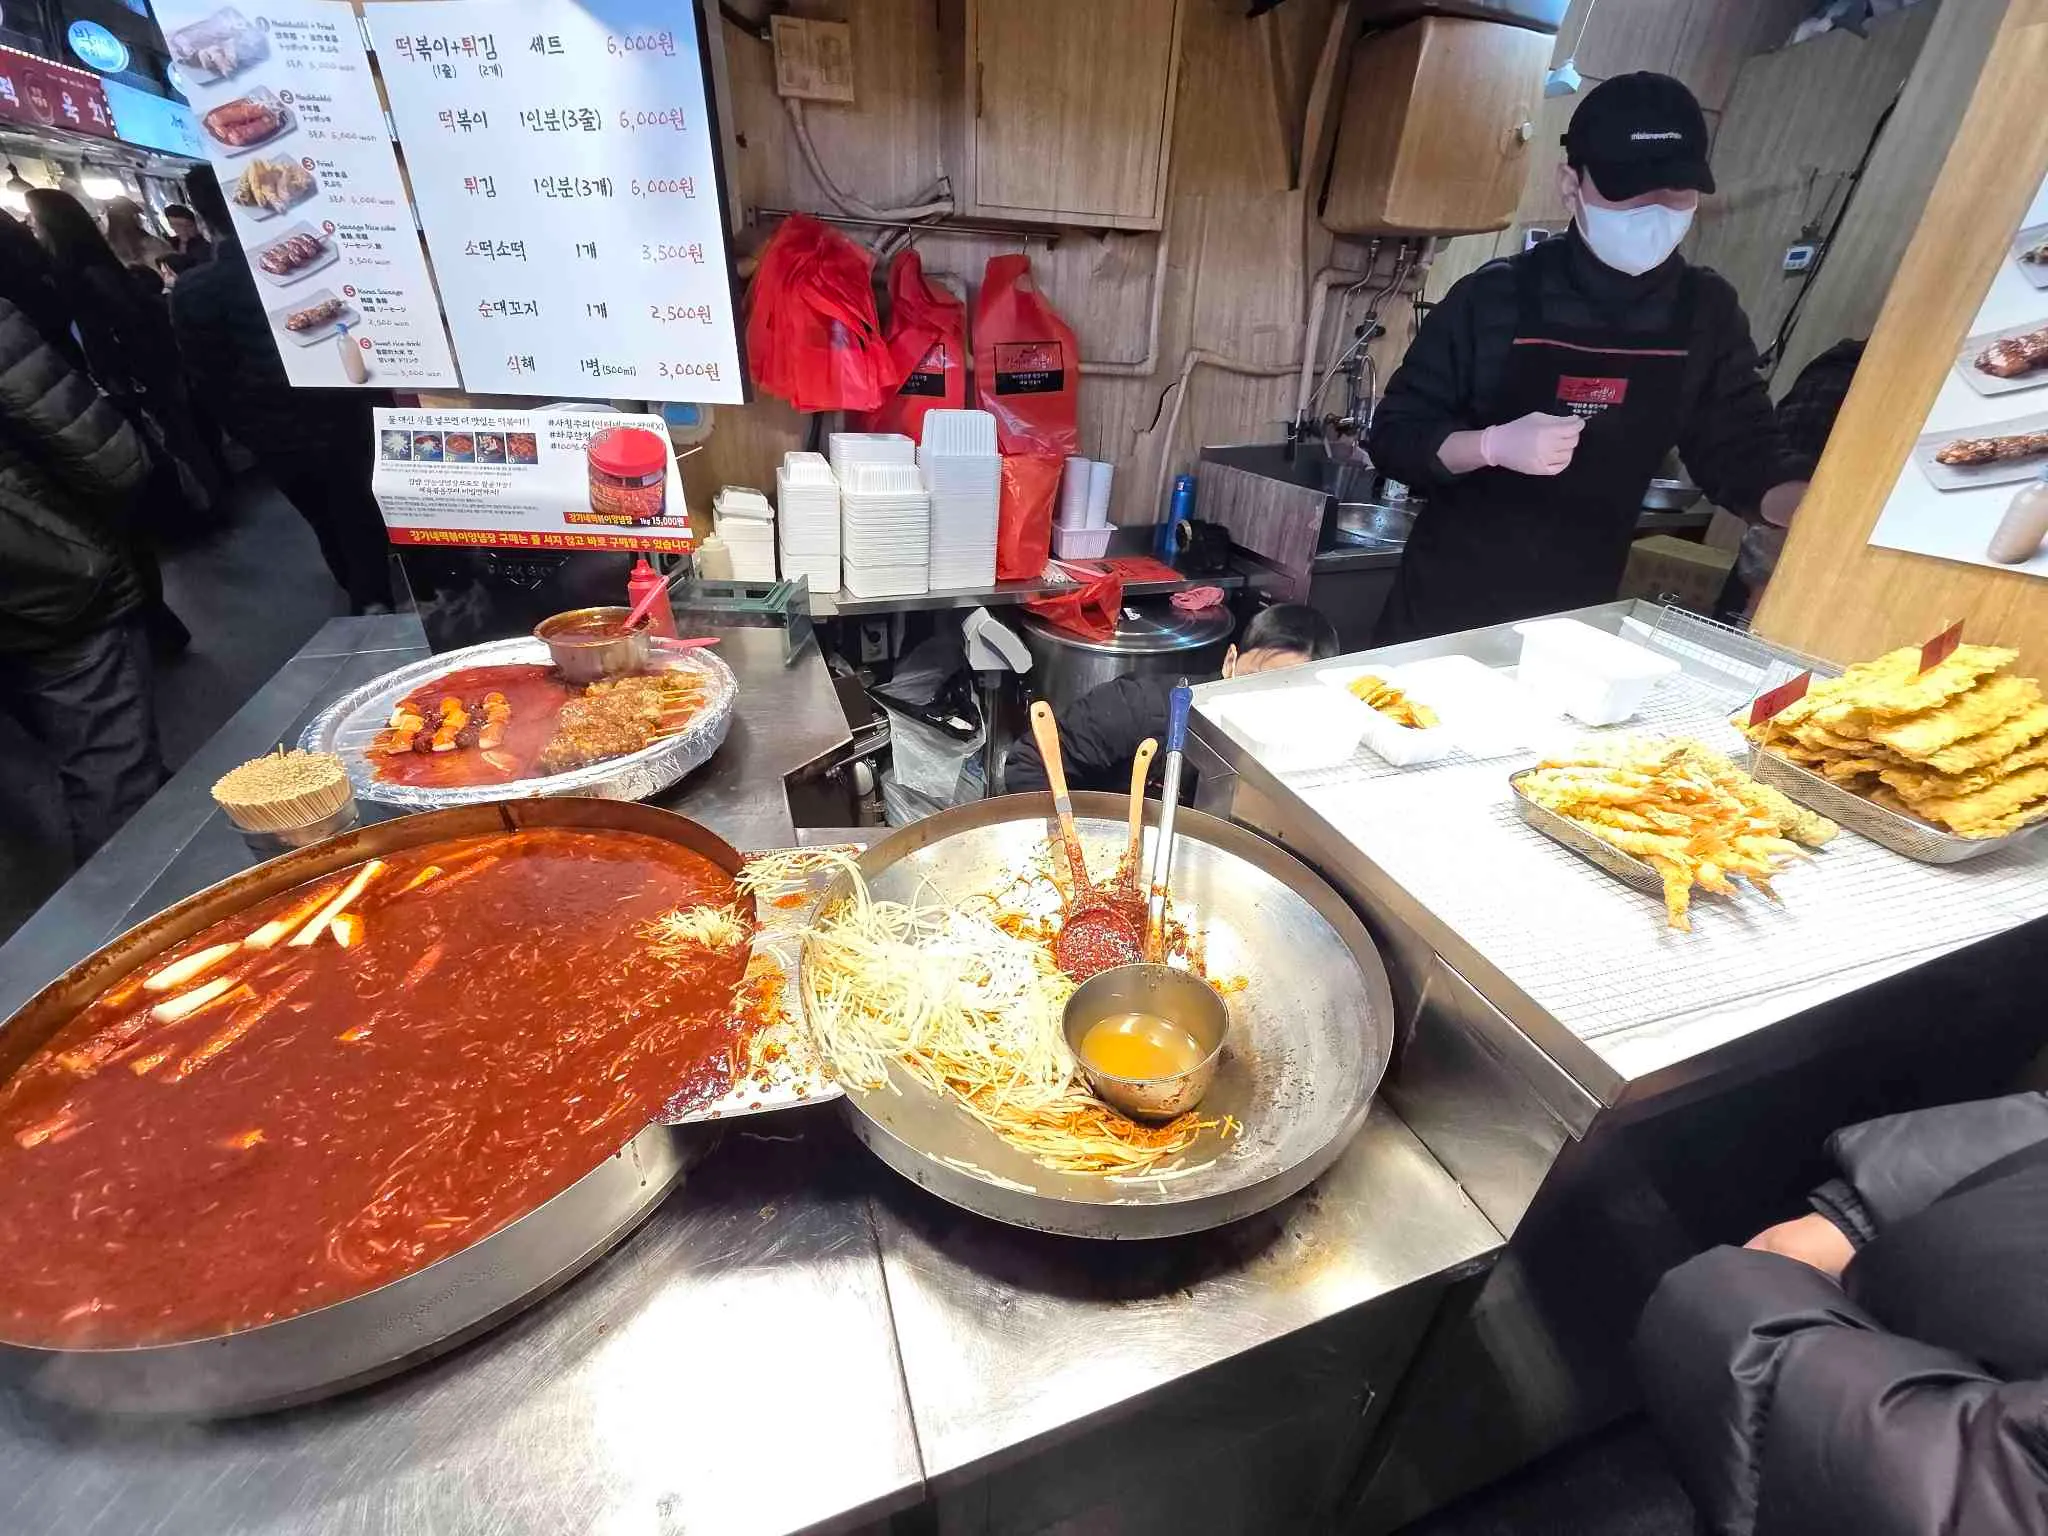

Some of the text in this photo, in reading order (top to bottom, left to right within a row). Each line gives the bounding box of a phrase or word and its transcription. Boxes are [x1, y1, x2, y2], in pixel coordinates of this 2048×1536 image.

[396, 32, 676, 61] 떡볶이+튀김 세트 6,000원
[479, 64, 504, 79] (2개)
[438, 107, 687, 134] 떡볶이 1인분(3줄) 6,000원
[464, 176, 695, 199] 튀김 1인분(3개) 6,000원
[465, 240, 704, 264] 소떡소떡 1개 3,500원
[479, 299, 712, 325] 순대꼬지 1개 2,500원
[507, 355, 535, 376] 식혜
[659, 362, 721, 382] 3,000원
[651, 516, 685, 527] 15,000원
[640, 538, 652, 550] 수
